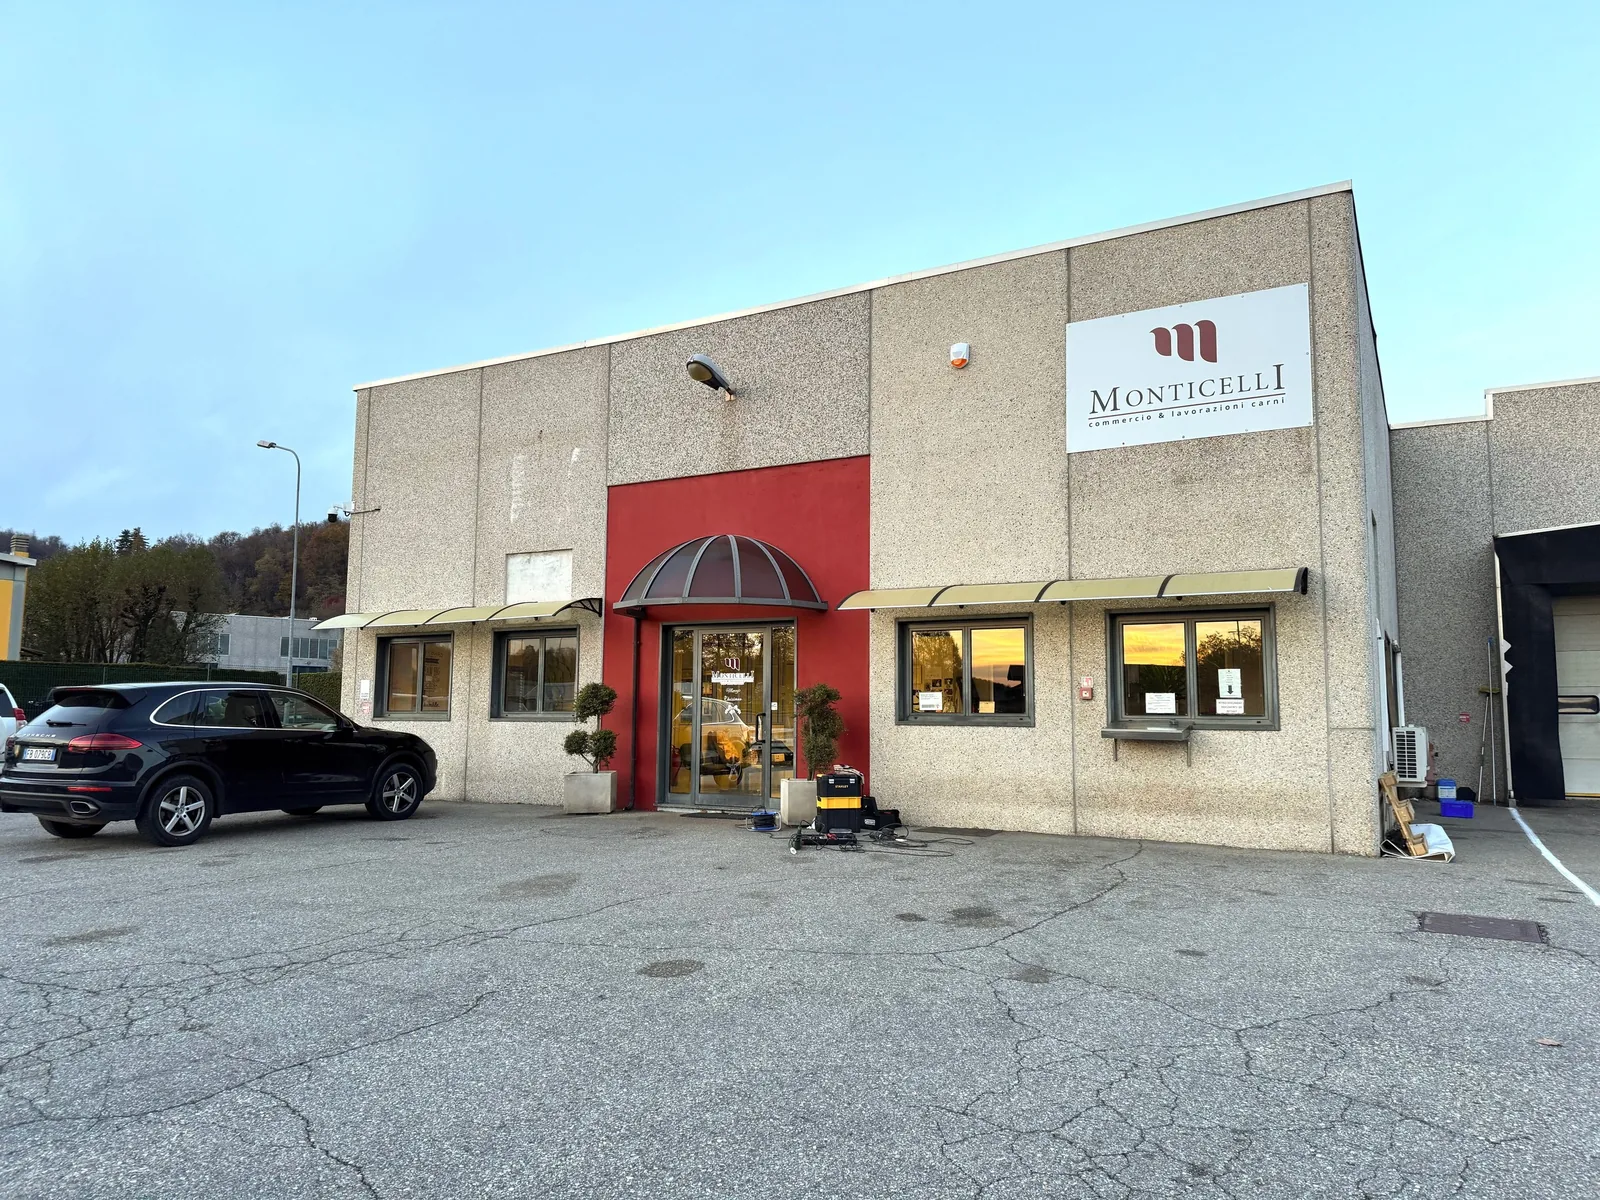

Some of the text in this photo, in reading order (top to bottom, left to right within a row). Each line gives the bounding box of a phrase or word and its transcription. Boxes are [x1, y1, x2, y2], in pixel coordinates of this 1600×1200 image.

[1089, 363, 1285, 415] MONTICELLI
[1088, 414, 1152, 428] commercio
[1171, 401, 1244, 417] lavorazioni
[1251, 397, 1285, 408] carni
